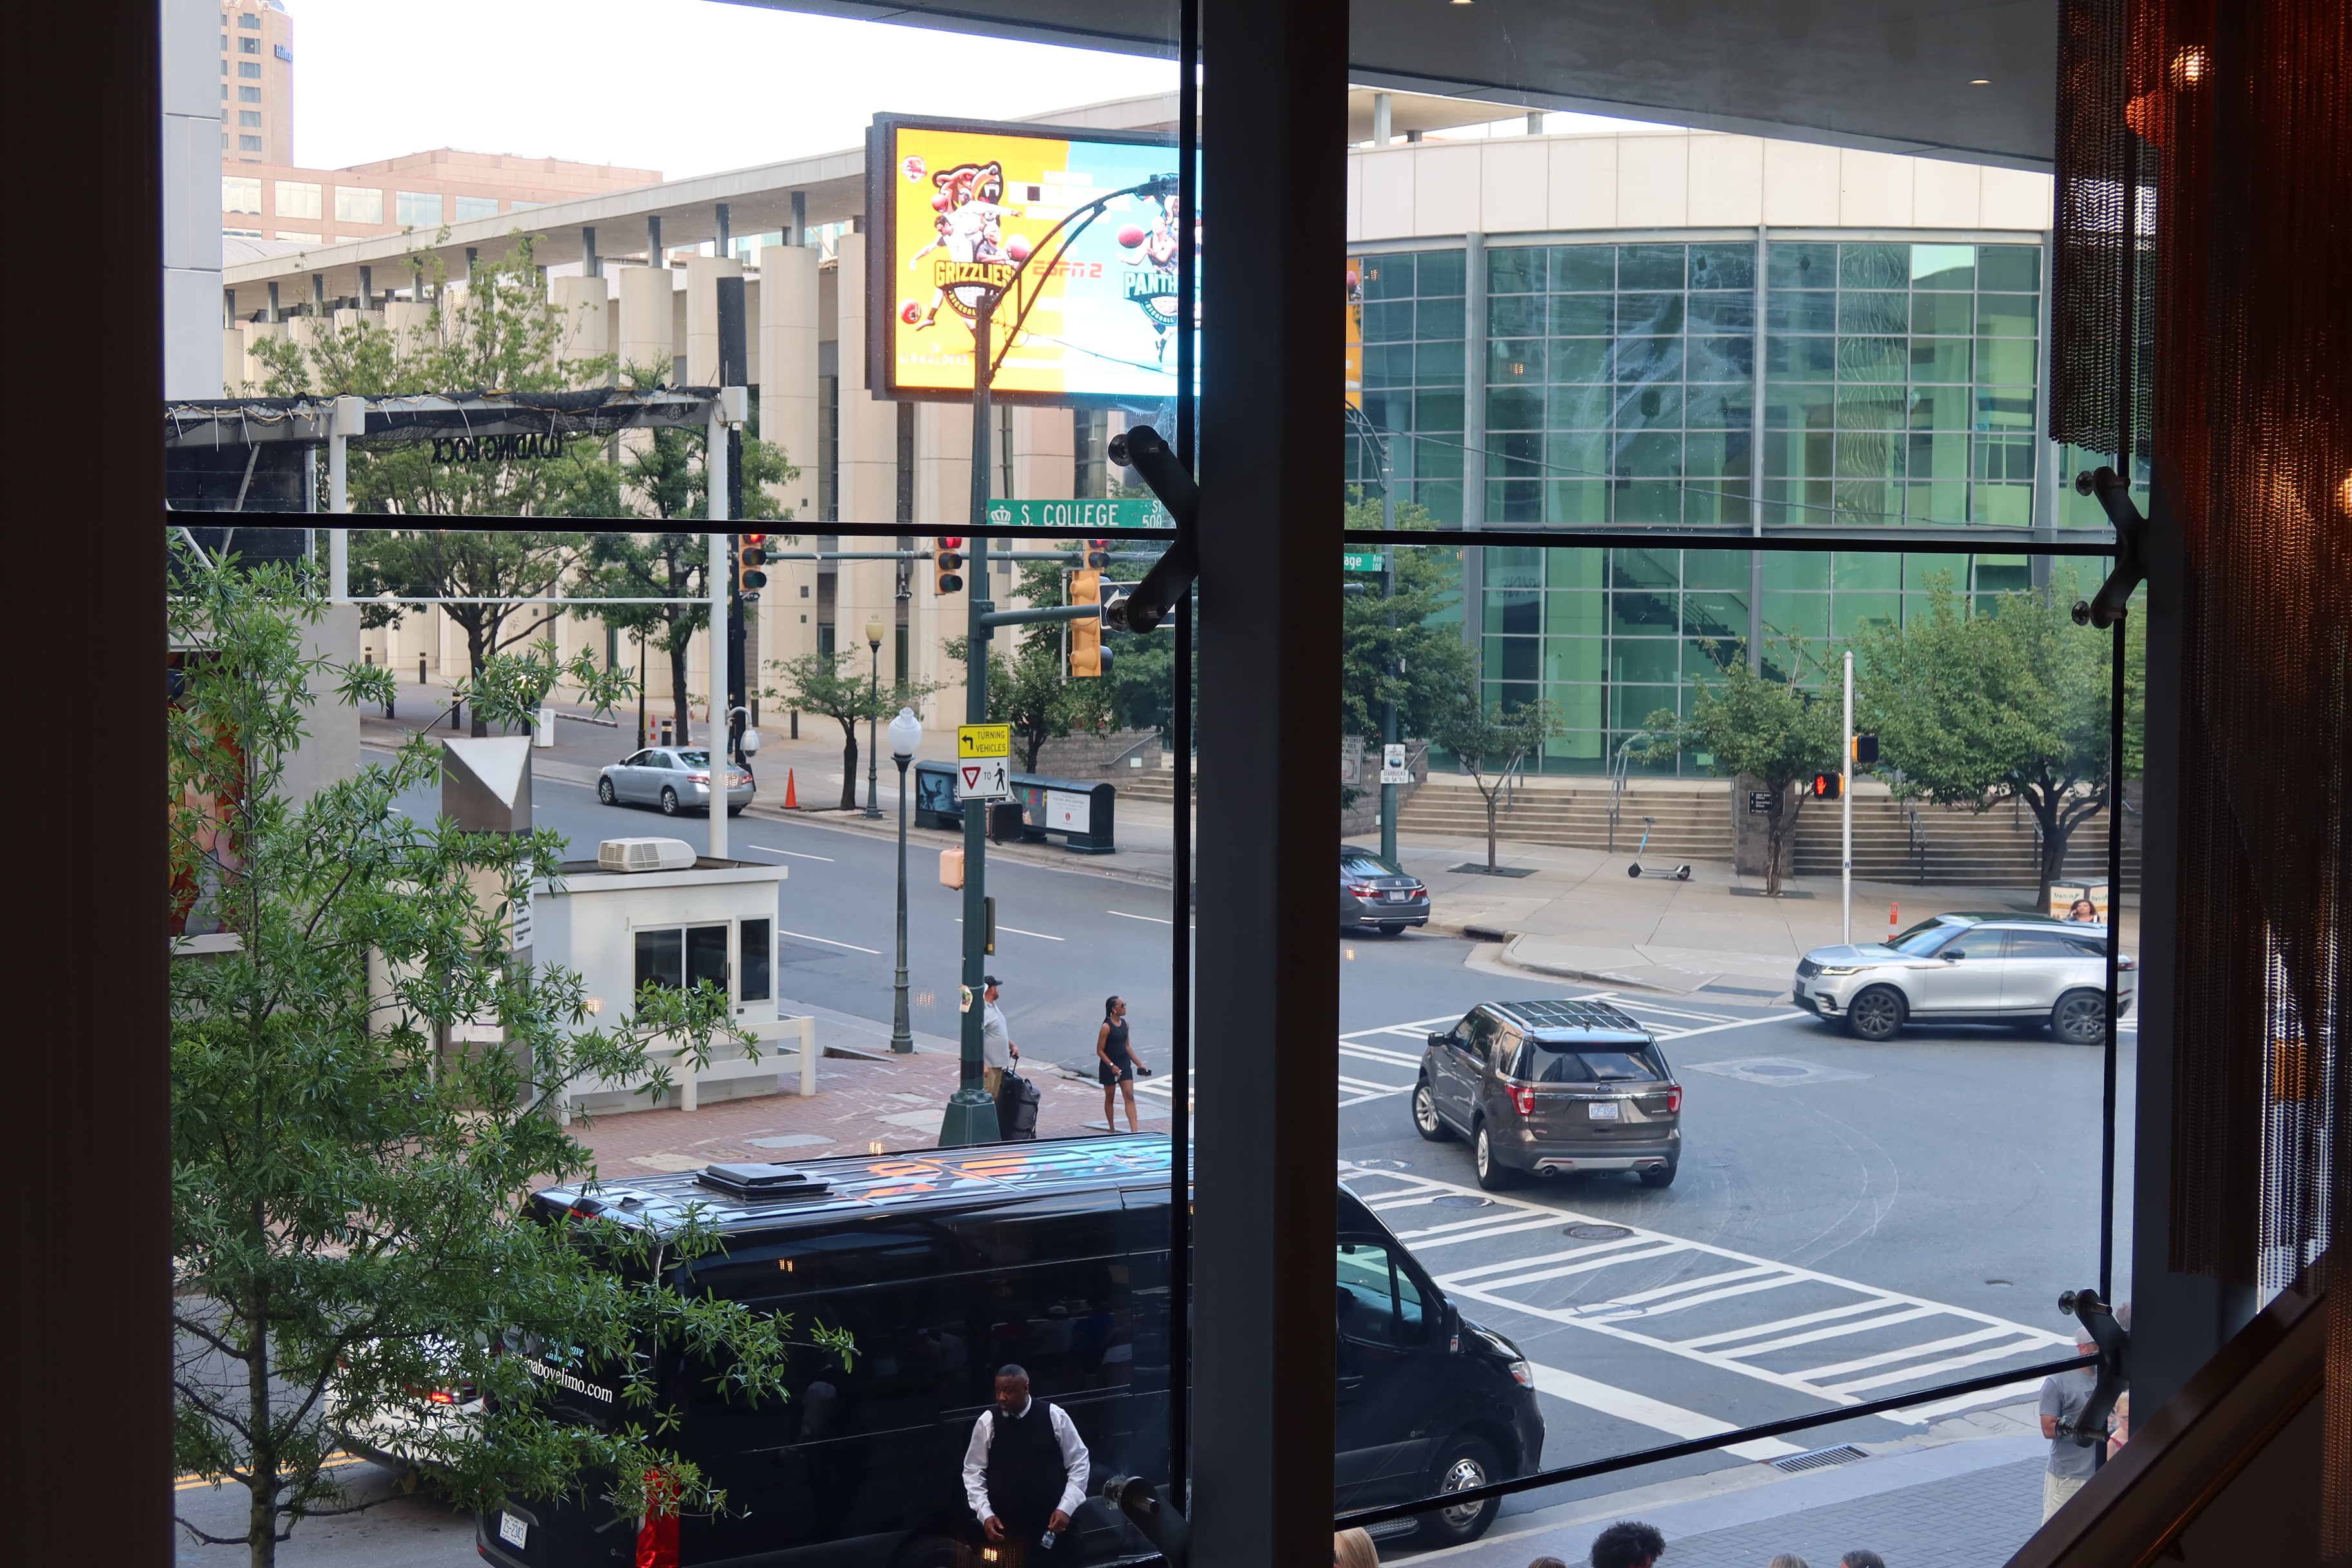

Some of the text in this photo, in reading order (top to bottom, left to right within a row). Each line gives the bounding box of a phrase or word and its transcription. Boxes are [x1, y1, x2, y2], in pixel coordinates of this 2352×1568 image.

[935, 260, 1012, 288] GRIZZLIES
[1032, 260, 1102, 278] ESPN 2
[899, 352, 969, 366] CHARLOTTE
[1021, 504, 1034, 526] S.
[1043, 504, 1119, 527] COLLEGE
[1142, 514, 1162, 529] 500
[1344, 554, 1382, 570] age Ave
[1373, 563, 1382, 572] 100
[977, 730, 1005, 740] TURNING
[975, 743, 1006, 753] VEHICLES
[984, 771, 992, 780] TO
